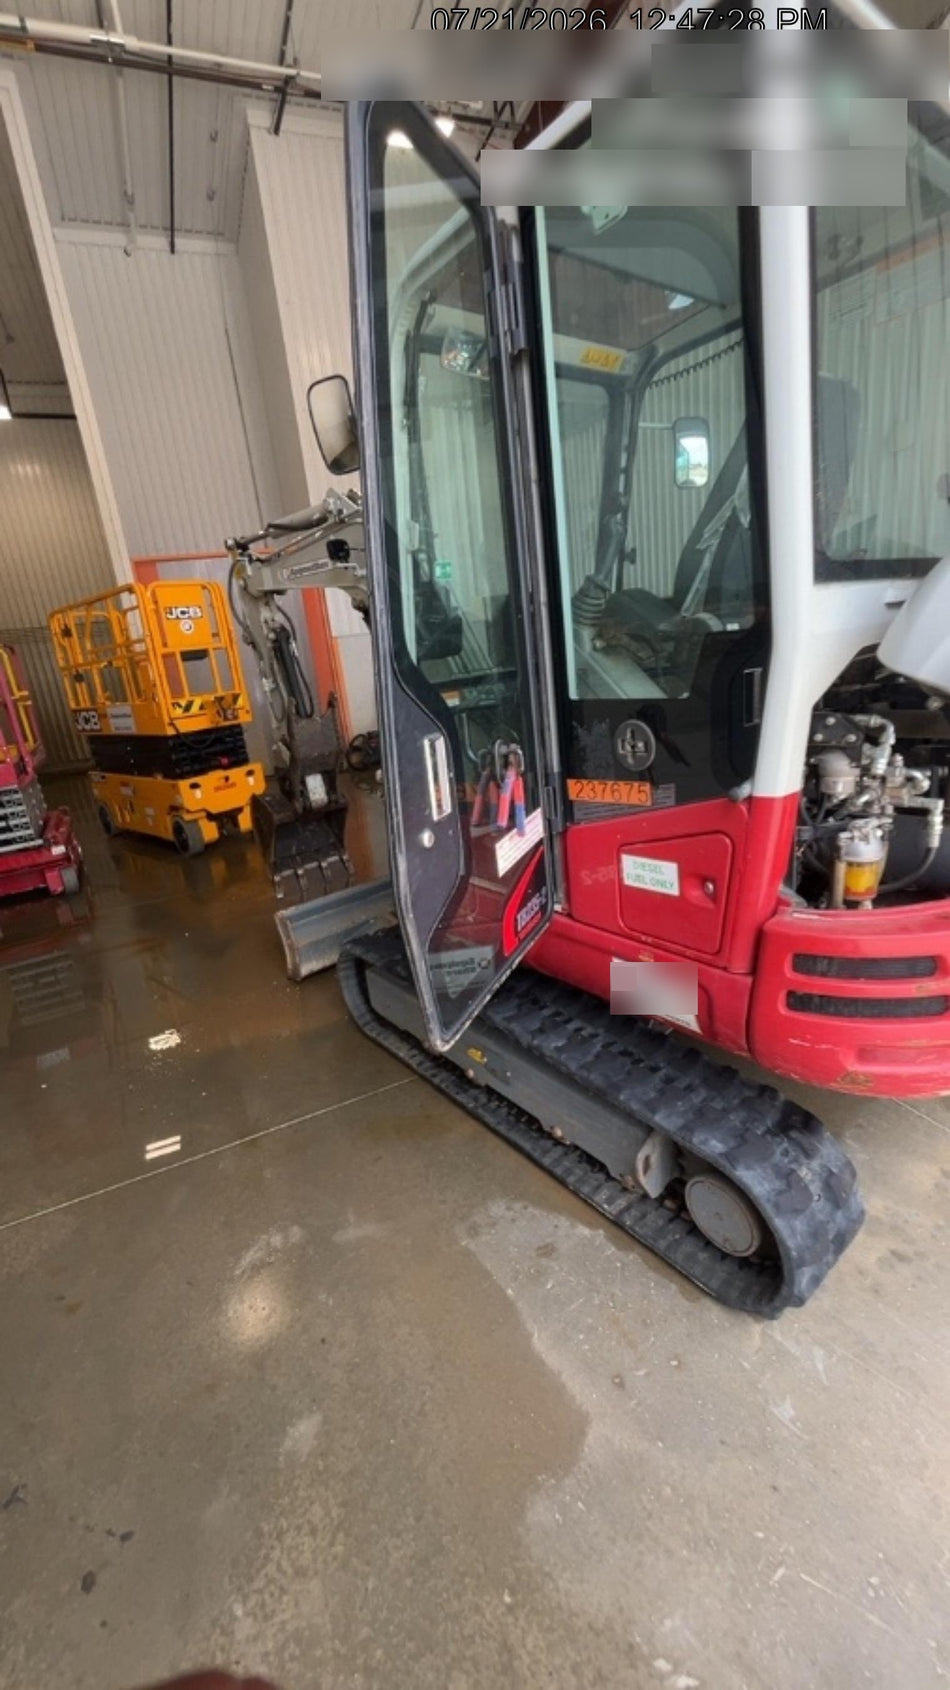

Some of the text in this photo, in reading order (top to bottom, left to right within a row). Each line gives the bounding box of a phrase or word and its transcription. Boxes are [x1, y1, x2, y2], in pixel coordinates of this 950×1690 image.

[166, 606, 202, 619] JCB
[77, 711, 100, 730] JCB
[574, 780, 649, 803] 237675
[632, 860, 664, 875] DIESEL
[626, 872, 674, 889] FUEL ONLY
